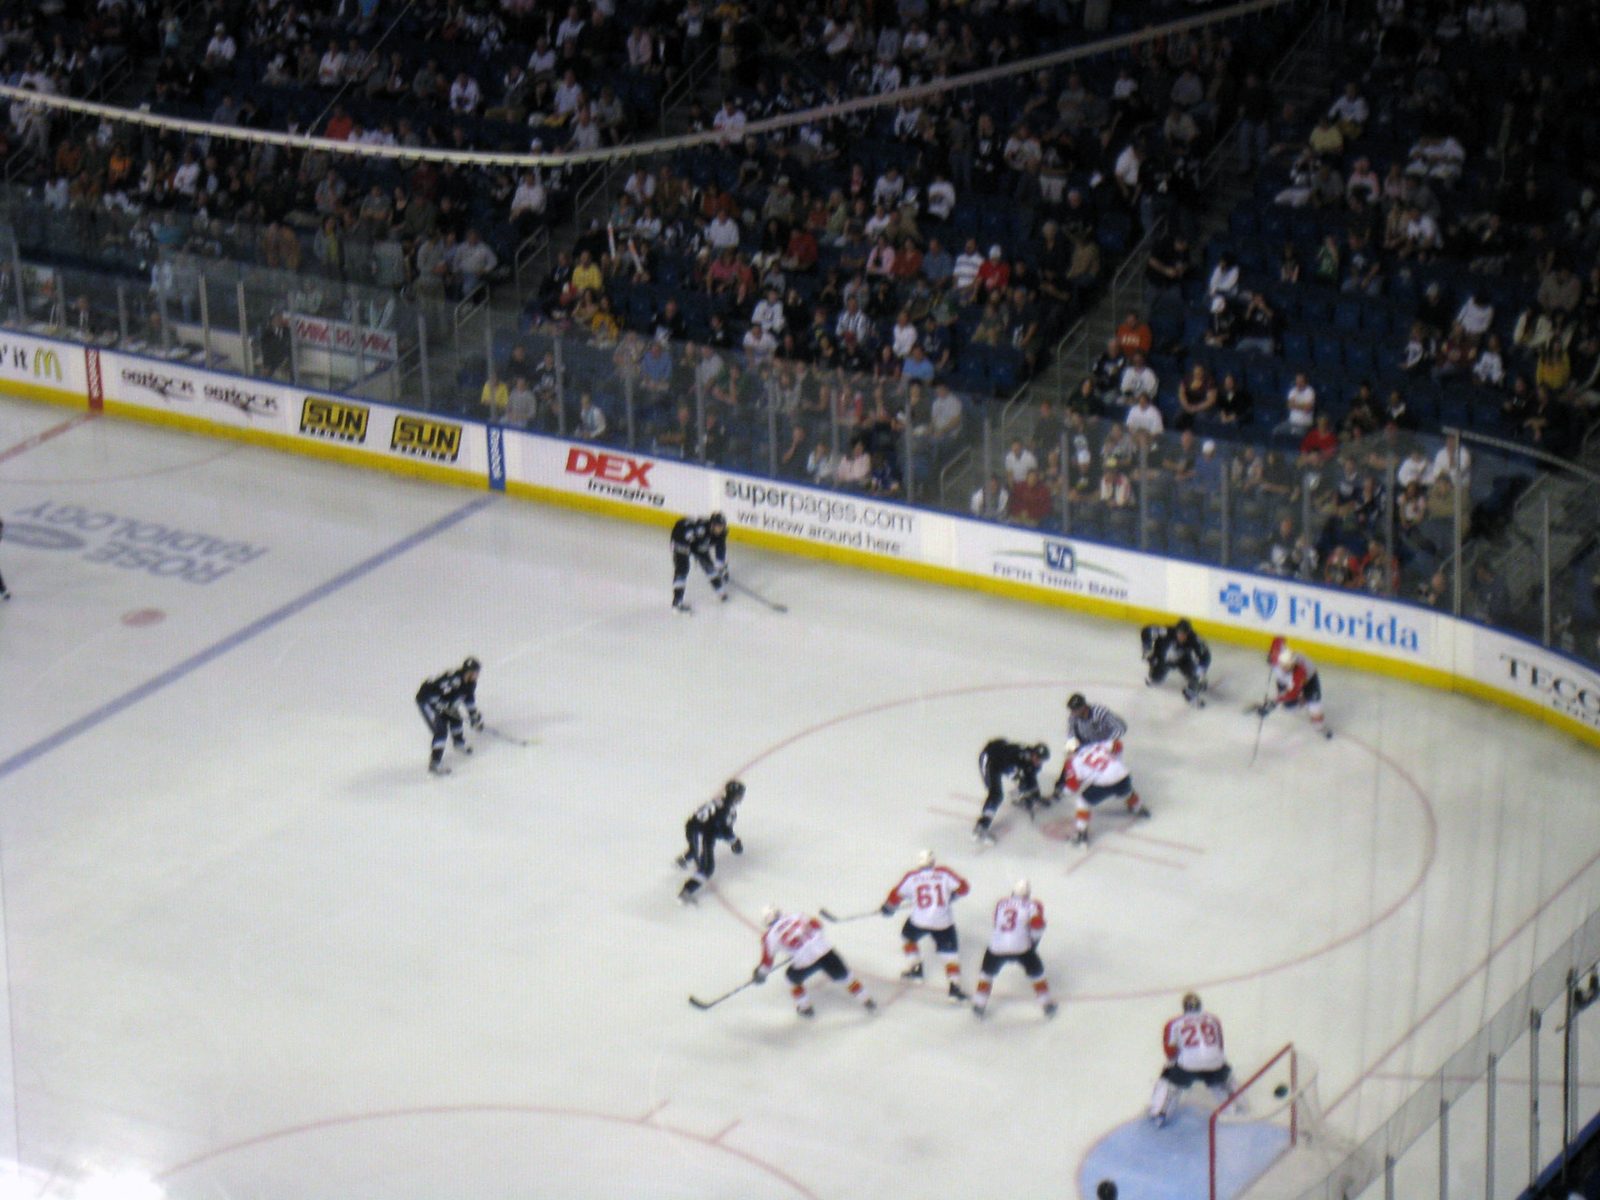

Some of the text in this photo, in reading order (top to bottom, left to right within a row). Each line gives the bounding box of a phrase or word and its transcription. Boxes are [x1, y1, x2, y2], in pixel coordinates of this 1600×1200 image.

[12, 346, 28, 371] it
[308, 402, 363, 432] SUN
[399, 420, 456, 455] SUN
[565, 447, 654, 488] DEX
[724, 478, 914, 533] superpages.com
[737, 508, 902, 555] we know around here
[993, 562, 1129, 601] FIFTH THIRD BANK
[1288, 596, 1420, 652] Florida
[916, 884, 945, 910] 61
[1001, 908, 1018, 932] 3
